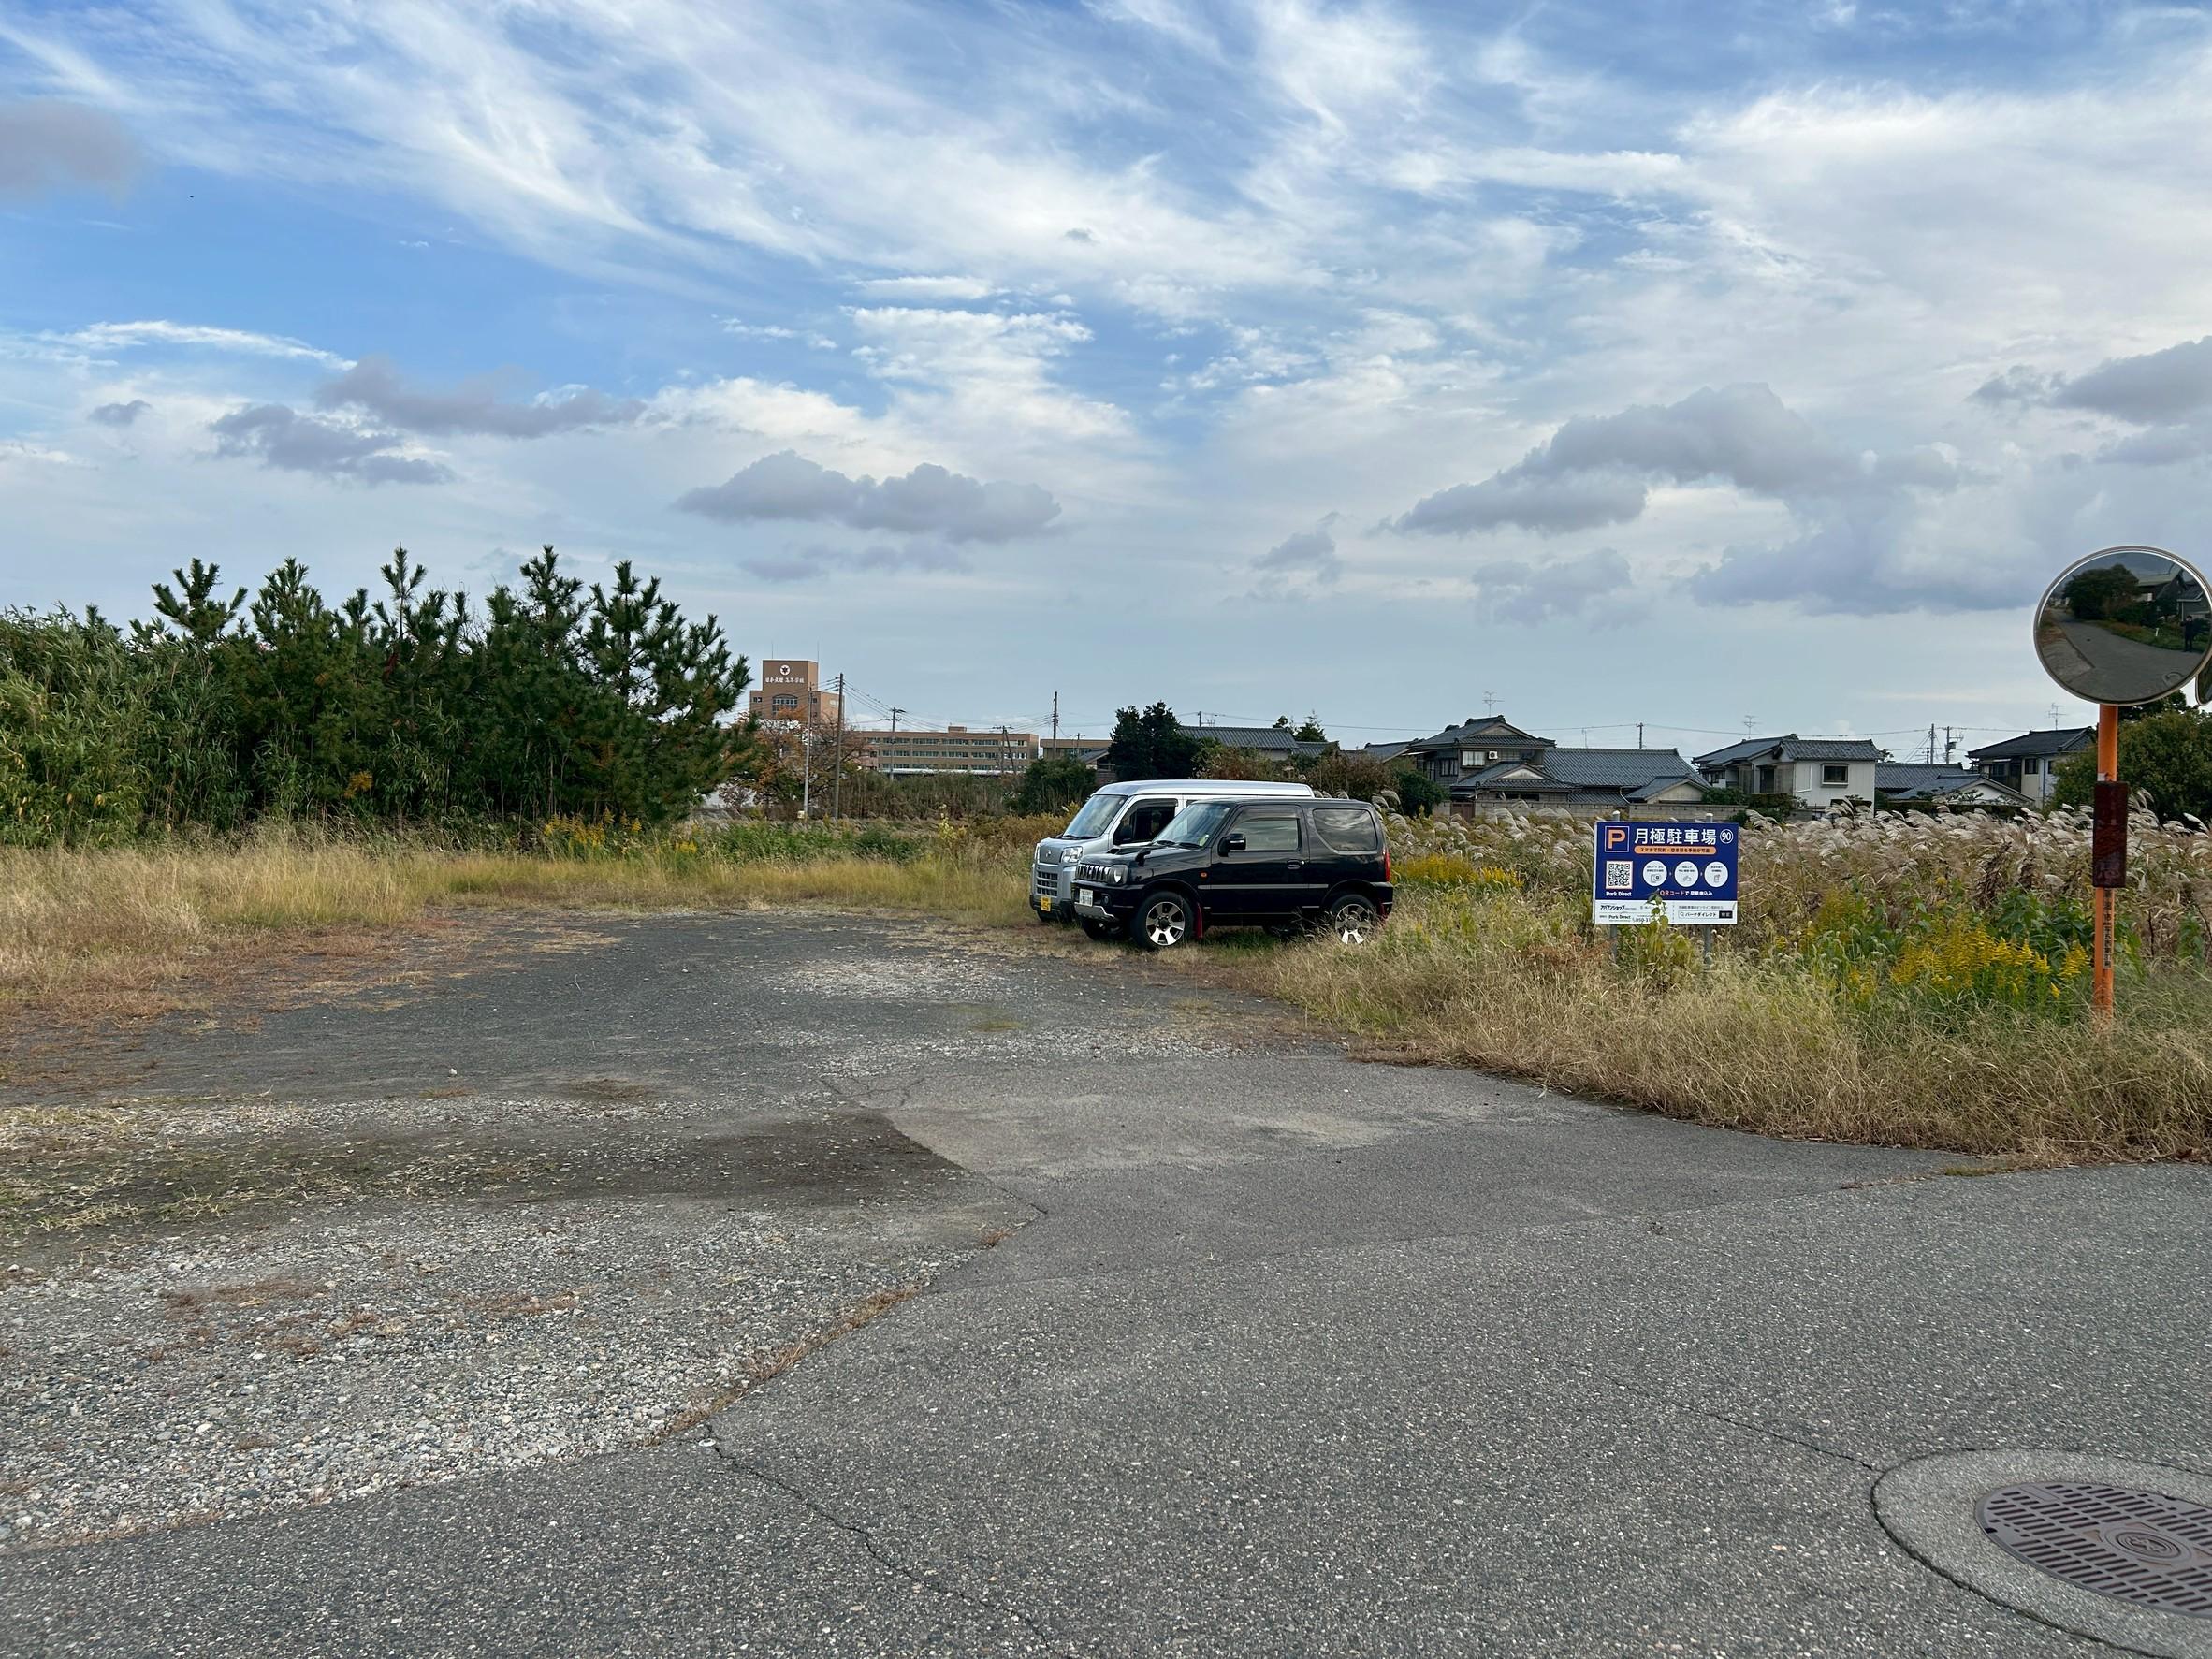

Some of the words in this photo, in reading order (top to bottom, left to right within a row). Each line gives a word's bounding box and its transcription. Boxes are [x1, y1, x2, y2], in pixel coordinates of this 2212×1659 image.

[1608, 829, 1626, 849] P
[1634, 828, 1716, 845] 月極駐車場
